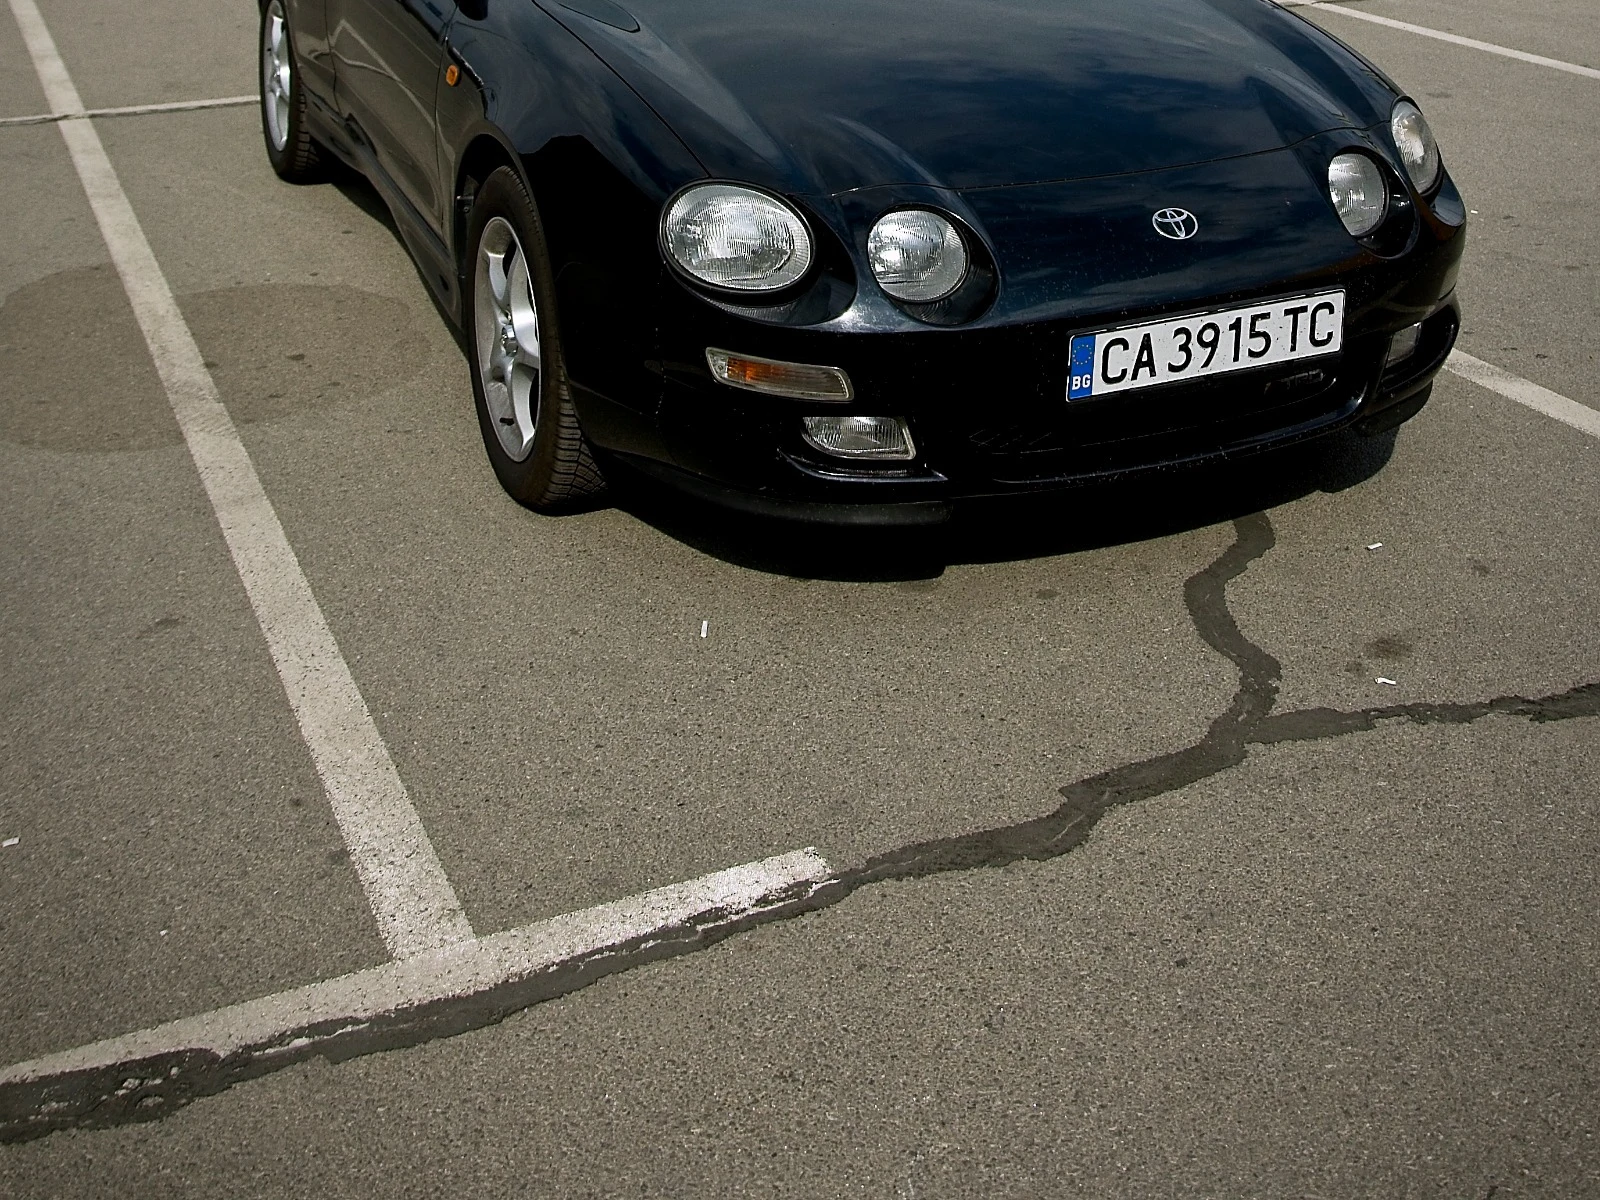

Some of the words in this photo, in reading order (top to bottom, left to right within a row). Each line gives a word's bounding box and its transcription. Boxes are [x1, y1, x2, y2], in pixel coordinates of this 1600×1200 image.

[1101, 332, 1157, 385] CA
[1167, 311, 1272, 374] 3915
[1283, 301, 1335, 353] TC
[1071, 374, 1091, 391] BG
